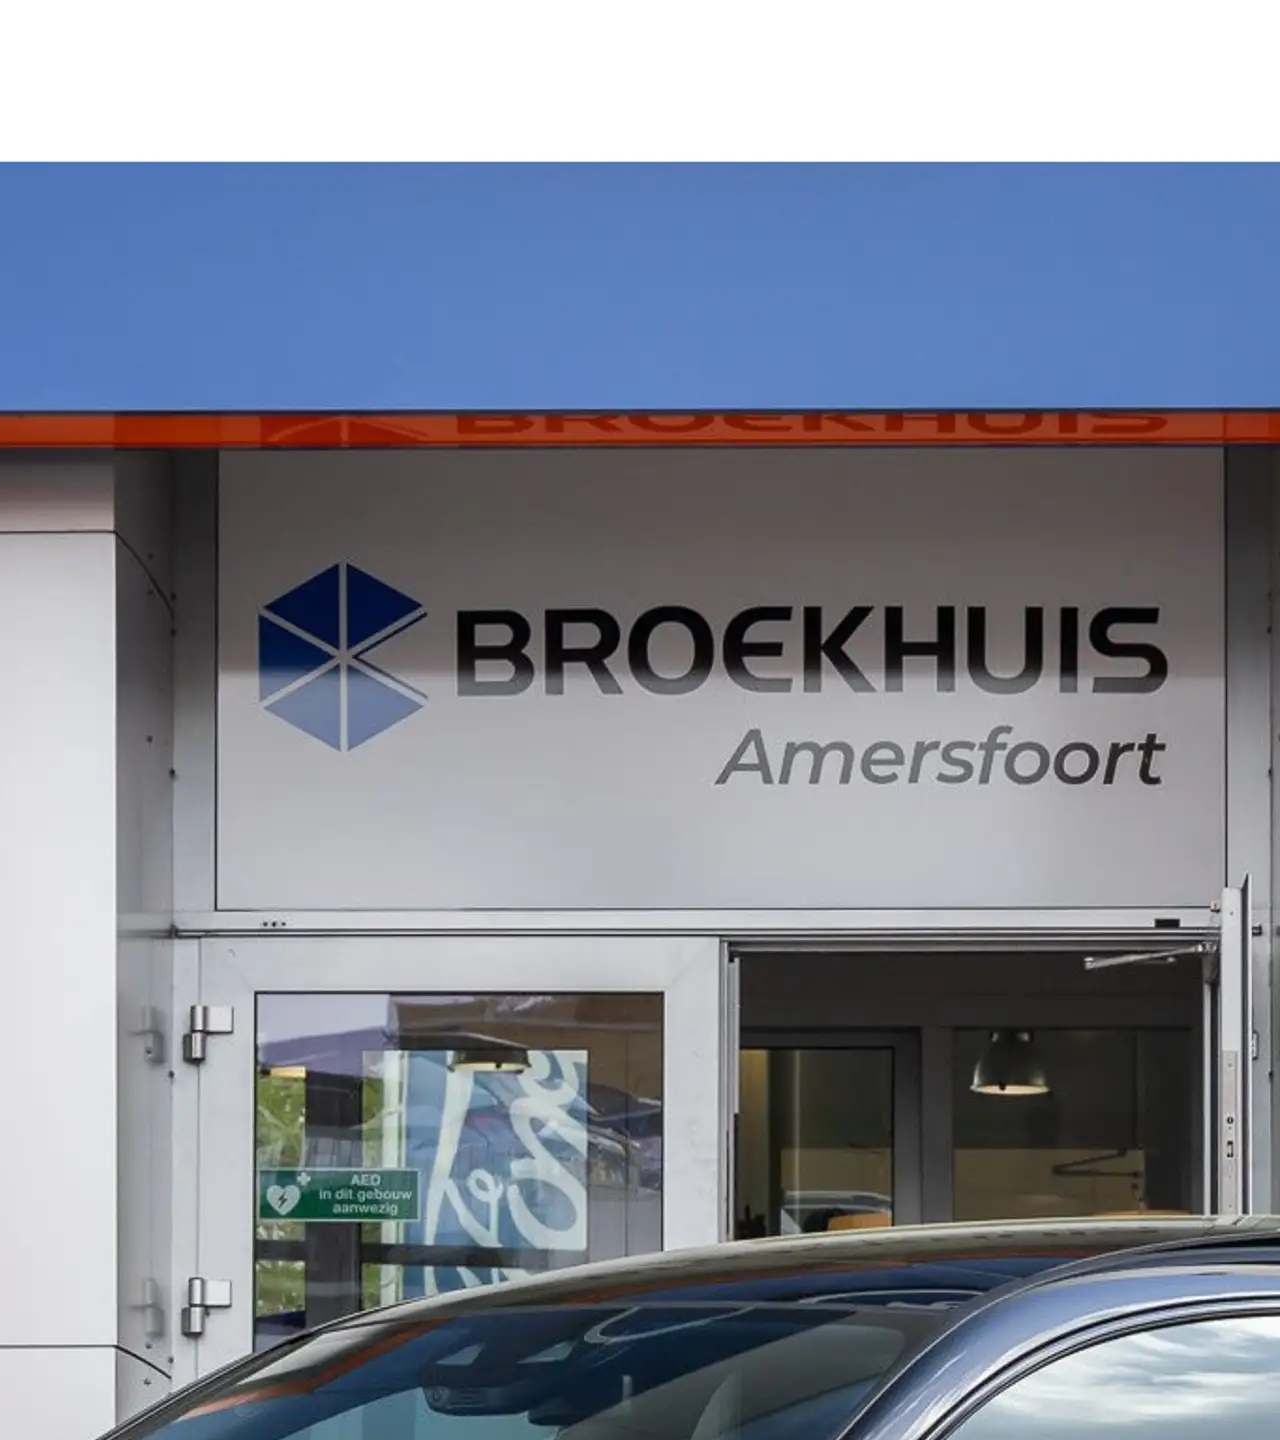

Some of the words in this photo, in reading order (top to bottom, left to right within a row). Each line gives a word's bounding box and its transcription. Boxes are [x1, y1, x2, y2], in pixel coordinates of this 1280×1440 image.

[456, 605, 1169, 697] BROEKHUIS
[714, 725, 1167, 786] Amersfoort
[351, 1174, 381, 1187] AED
[335, 1188, 353, 1200] dit
[356, 1188, 413, 1203] gebouw
[332, 1202, 399, 1216] aanwezig
